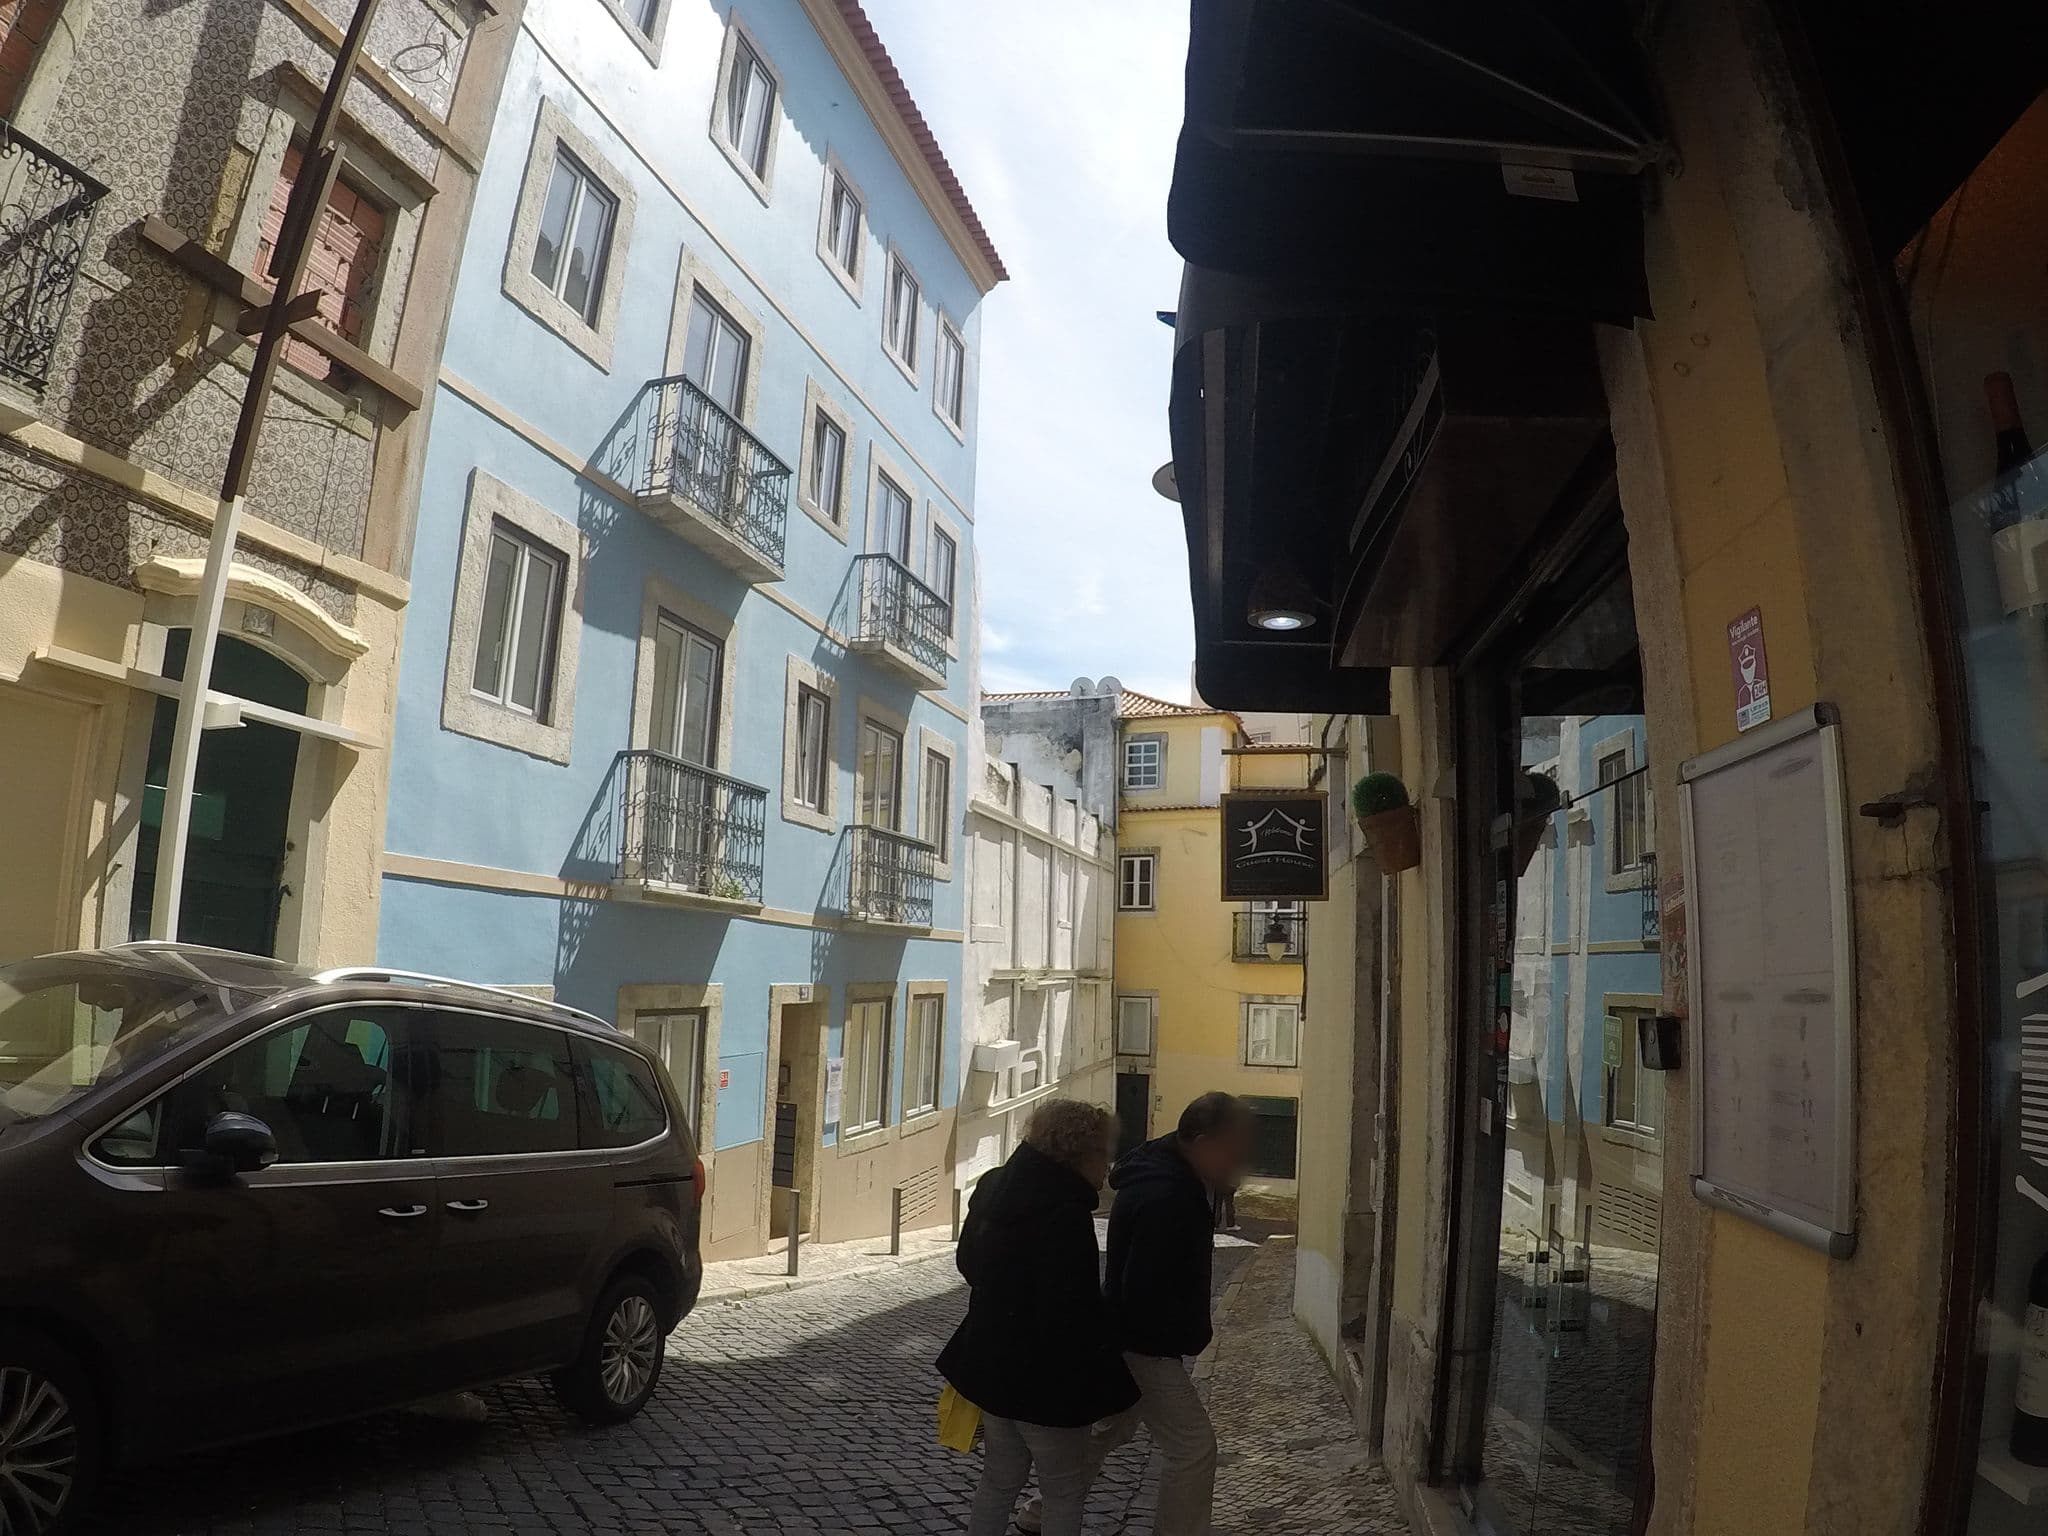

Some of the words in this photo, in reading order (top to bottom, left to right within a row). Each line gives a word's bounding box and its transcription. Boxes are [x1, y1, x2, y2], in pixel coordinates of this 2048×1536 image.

[1729, 615, 1759, 639] Vigilante
[1754, 680, 1768, 698] 24H
[1275, 857, 1314, 869] House
